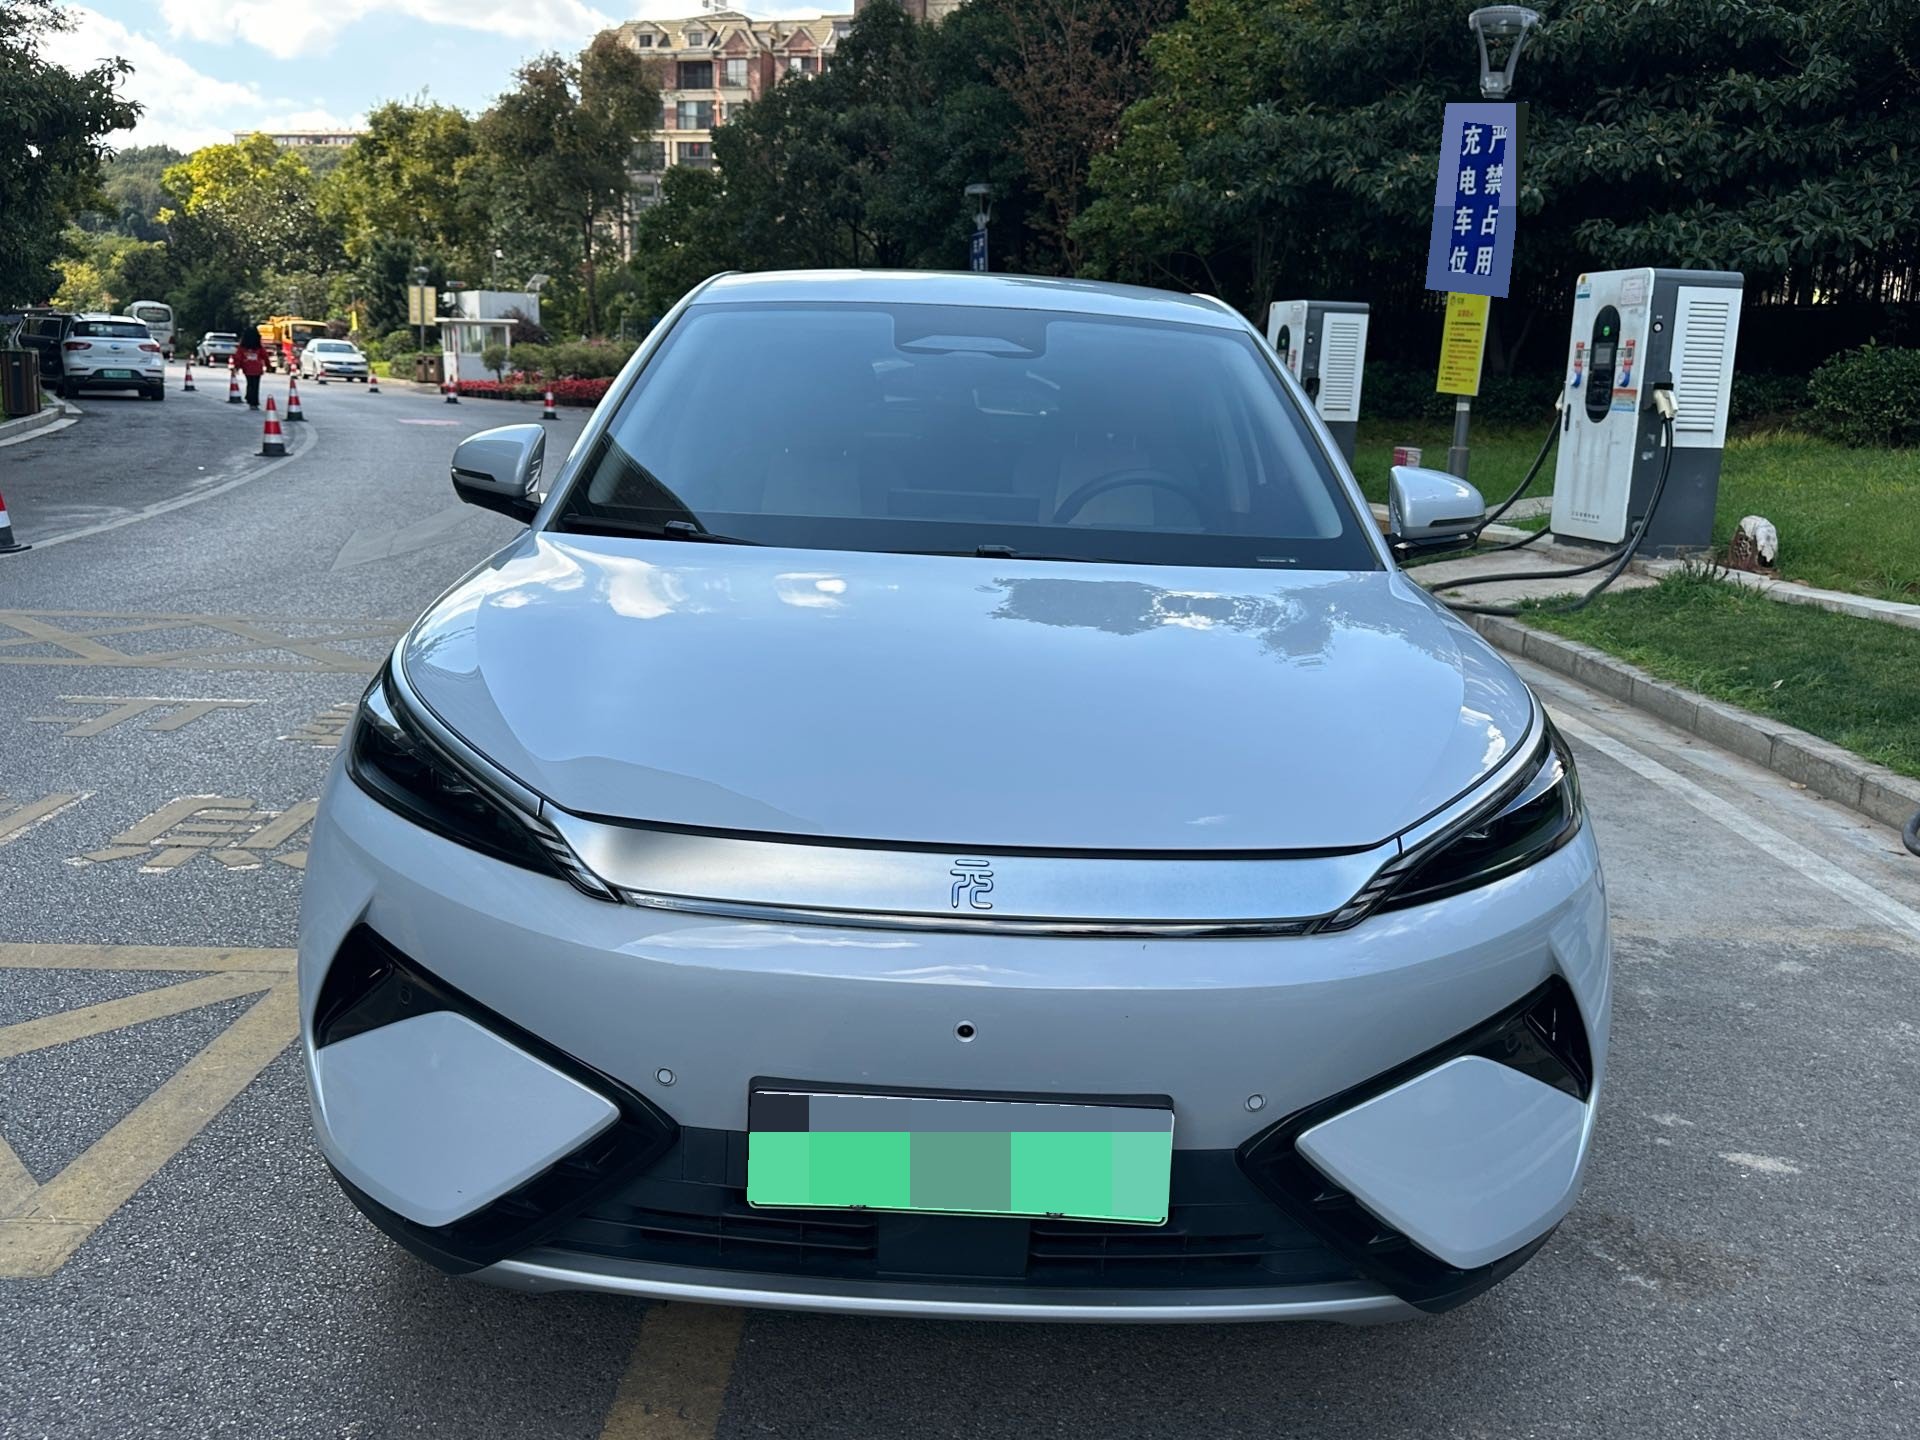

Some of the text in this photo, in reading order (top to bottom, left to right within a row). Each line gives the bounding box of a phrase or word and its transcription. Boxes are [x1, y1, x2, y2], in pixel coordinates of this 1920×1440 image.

[1449, 125, 1481, 274] 充电车位
[1474, 125, 1507, 276] 严禁占用
[949, 858, 994, 910] 元
